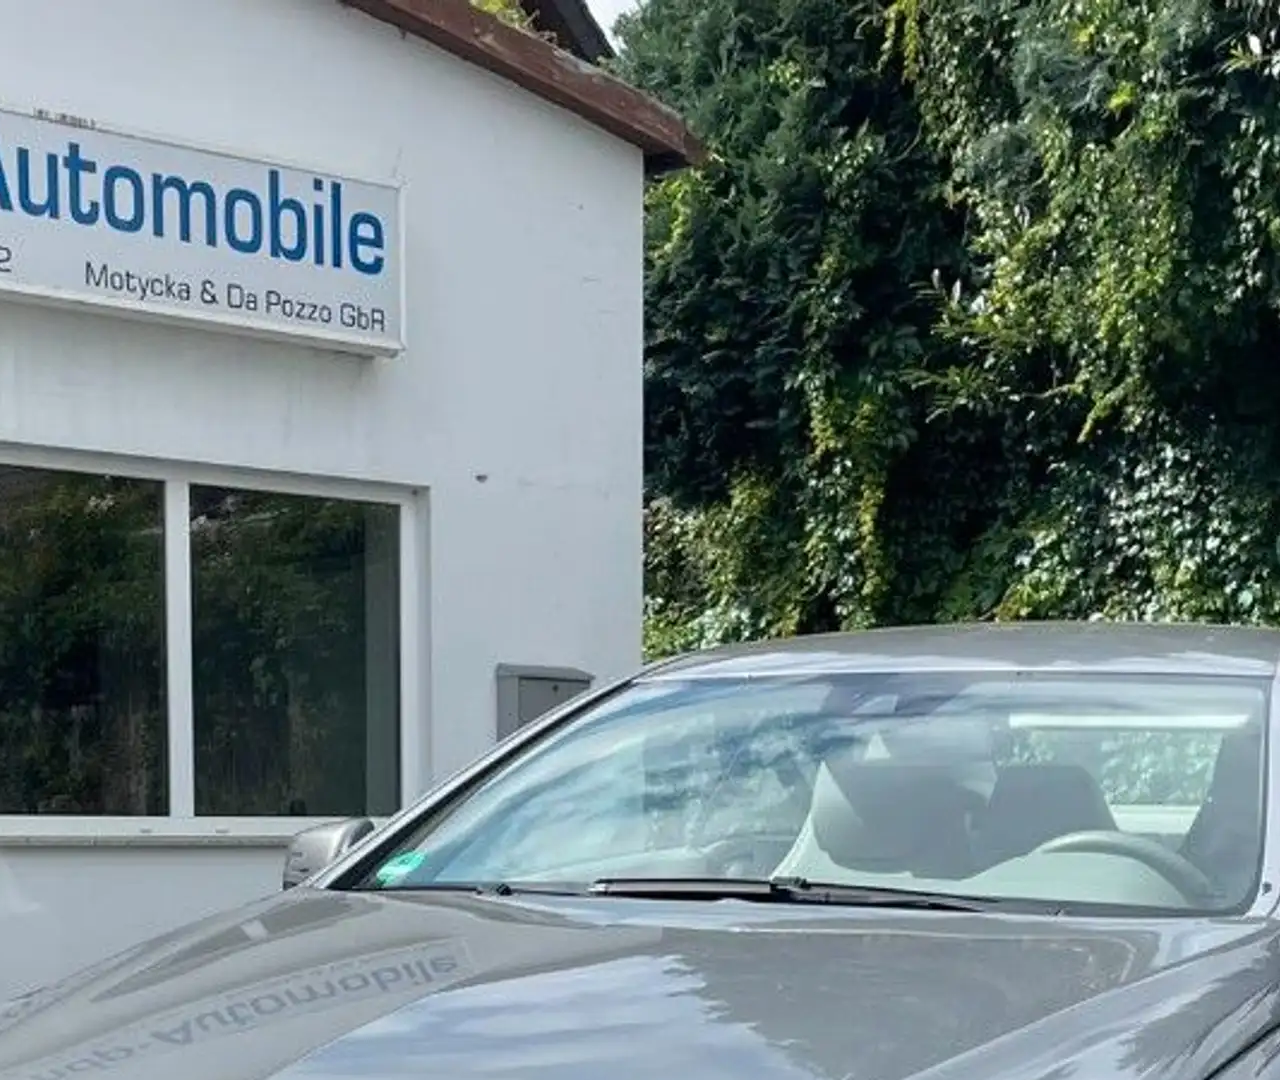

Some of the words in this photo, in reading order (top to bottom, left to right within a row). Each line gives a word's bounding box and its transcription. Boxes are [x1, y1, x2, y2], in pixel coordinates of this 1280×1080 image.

[84, 261, 191, 302] Motycka
[199, 279, 219, 304] &
[227, 283, 258, 311] Da
[265, 290, 332, 324] Pozzo
[339, 303, 386, 332] GbR
